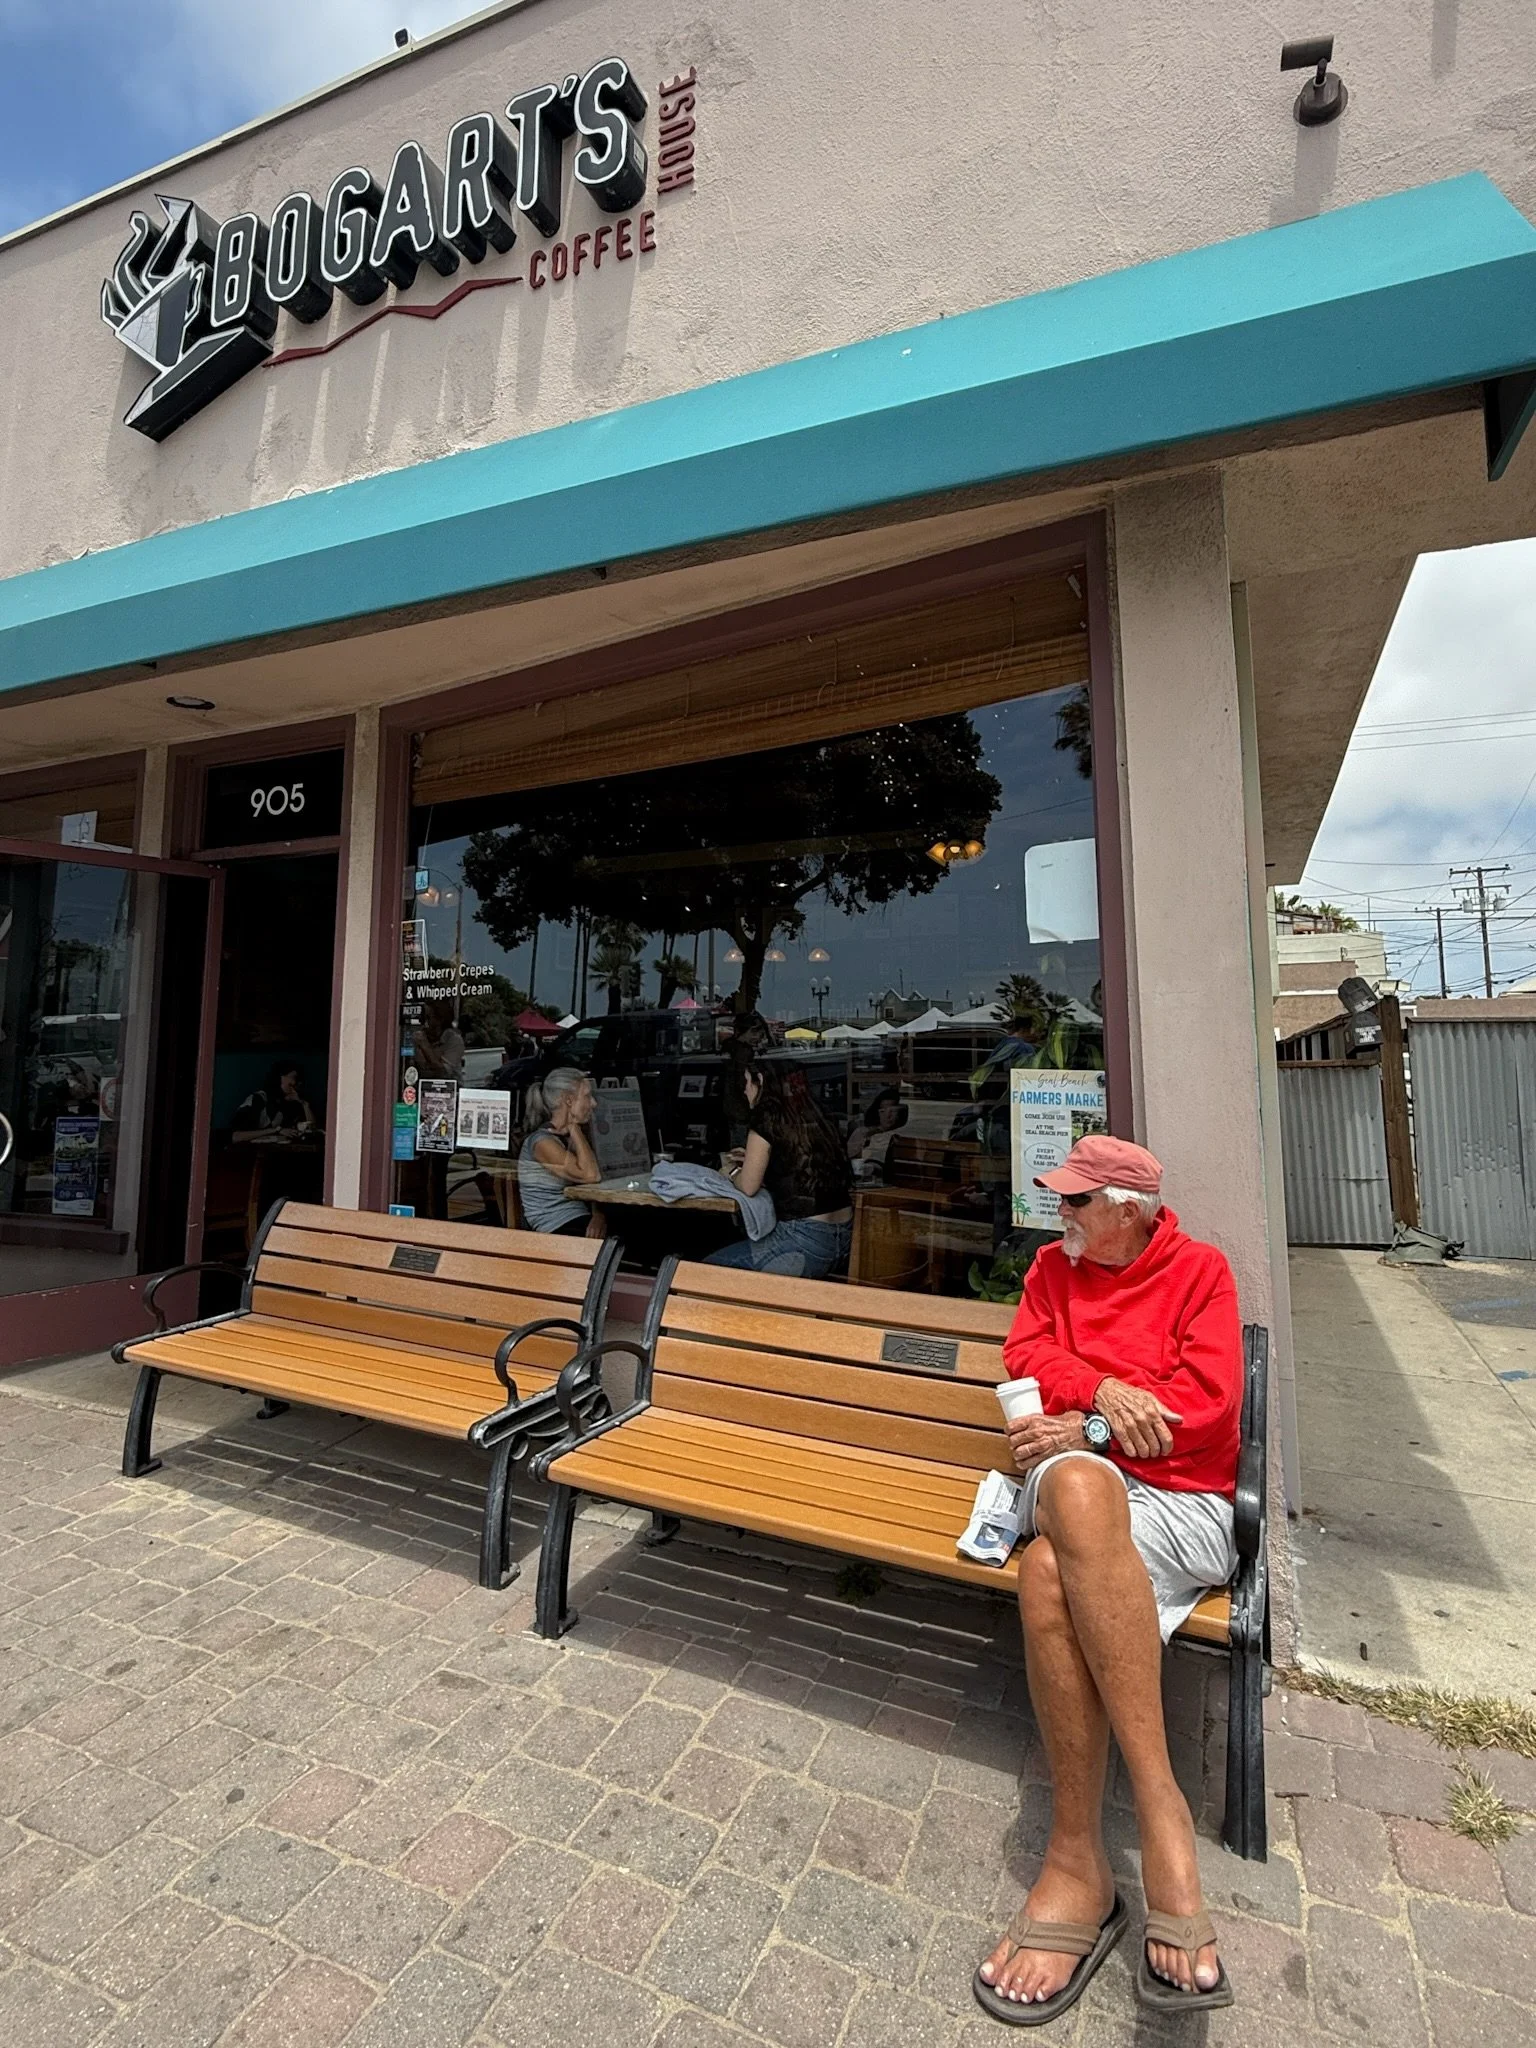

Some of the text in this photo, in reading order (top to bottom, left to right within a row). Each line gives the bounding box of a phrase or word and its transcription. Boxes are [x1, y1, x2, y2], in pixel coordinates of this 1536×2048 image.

[657, 66, 697, 195] HOUSE
[211, 56, 629, 328] BOGART'S
[528, 210, 657, 289] COFFEE
[250, 782, 305, 817] 905
[402, 963, 495, 981] Strawberry Crepes
[406, 983, 493, 1001] & Whipped Cream
[1037, 1072, 1089, 1089] Seal Beach
[1012, 1090, 1105, 1107] FARMERS MARKE
